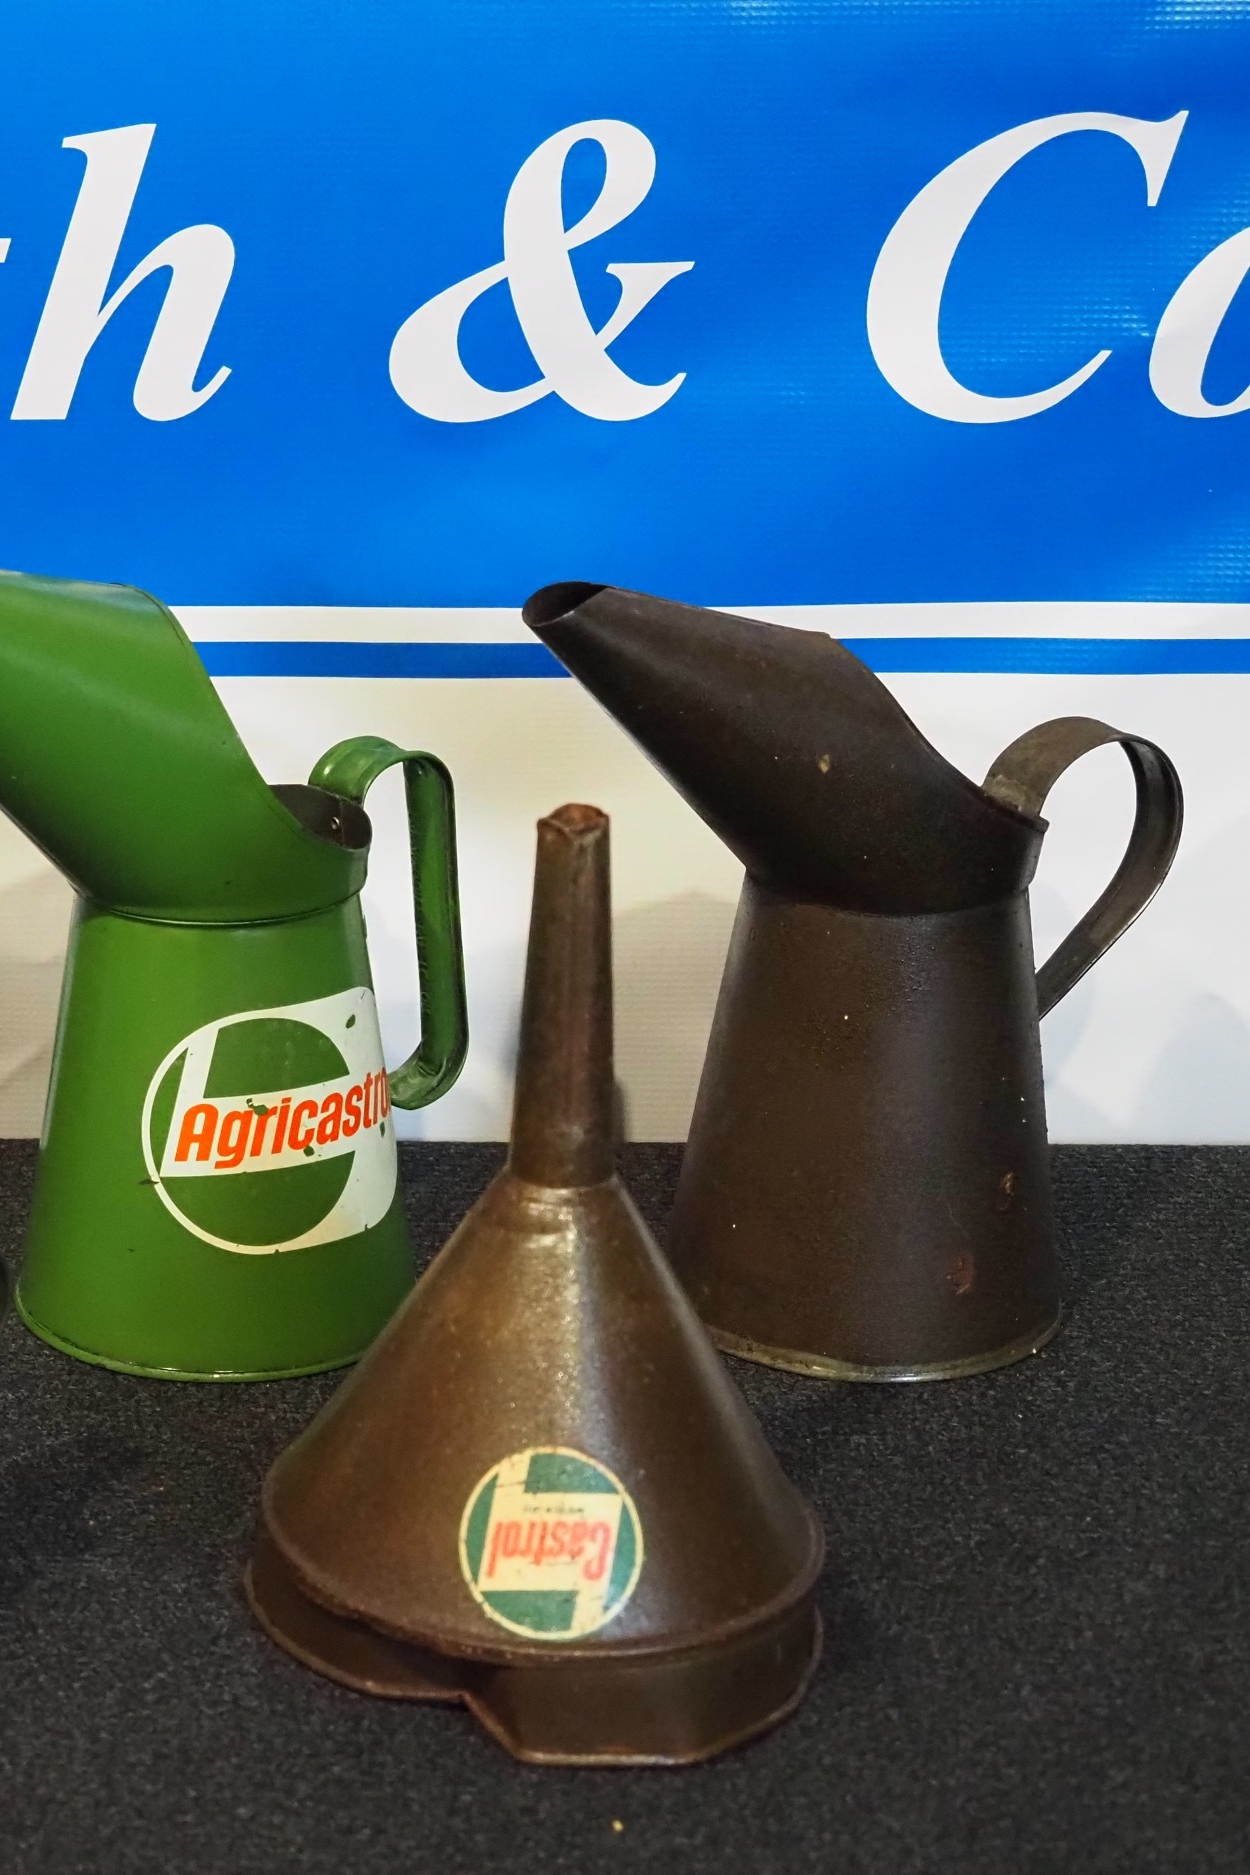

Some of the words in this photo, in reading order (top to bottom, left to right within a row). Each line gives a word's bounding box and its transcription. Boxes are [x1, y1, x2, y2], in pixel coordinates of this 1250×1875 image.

[388, 118, 696, 424] &
[174, 1066, 391, 1170] Agricastro
[485, 1520, 612, 1583] Castrol
